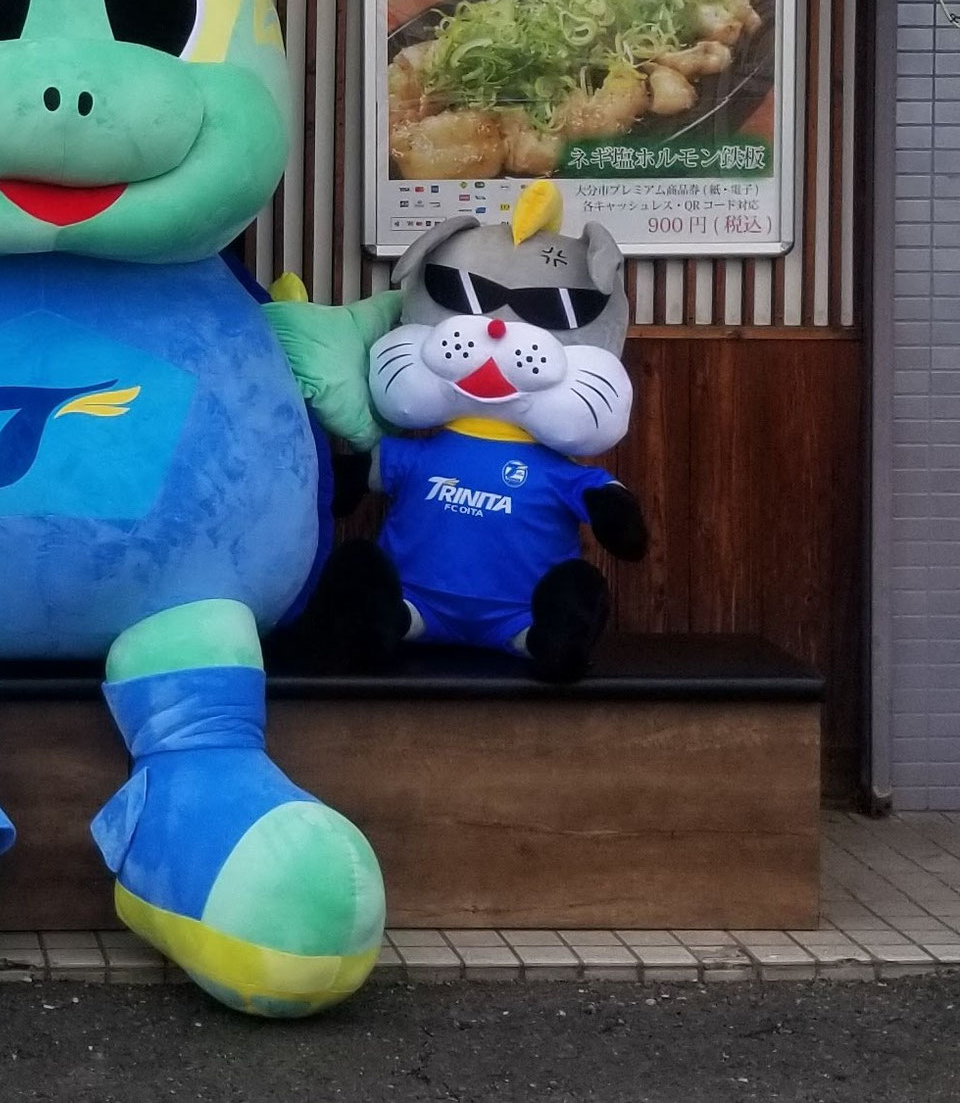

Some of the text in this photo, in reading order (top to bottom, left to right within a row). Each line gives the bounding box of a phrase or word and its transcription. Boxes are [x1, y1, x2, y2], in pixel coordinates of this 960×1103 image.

[568, 145, 766, 170] ネギ塩ホルモン鉄板
[425, 476, 512, 514] TRINITA
[444, 503, 484, 518] FC OITA
